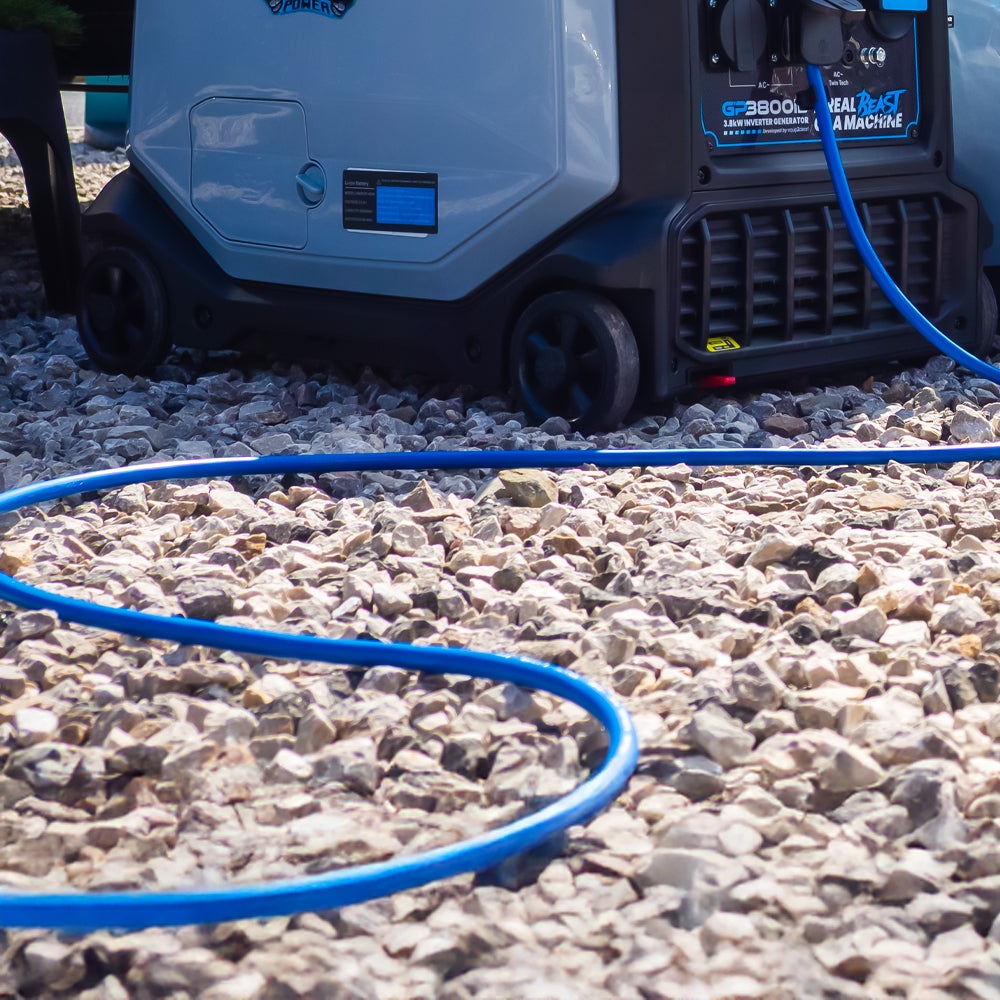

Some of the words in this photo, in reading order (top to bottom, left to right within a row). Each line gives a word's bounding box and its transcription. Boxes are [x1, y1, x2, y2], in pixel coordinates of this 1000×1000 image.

[855, 88, 908, 118] BEAST
[723, 119, 743, 128] 3.8kW
[744, 118, 773, 127] INVERTER
[773, 116, 809, 125] GENERATOR
[843, 112, 903, 131] MACHINE
